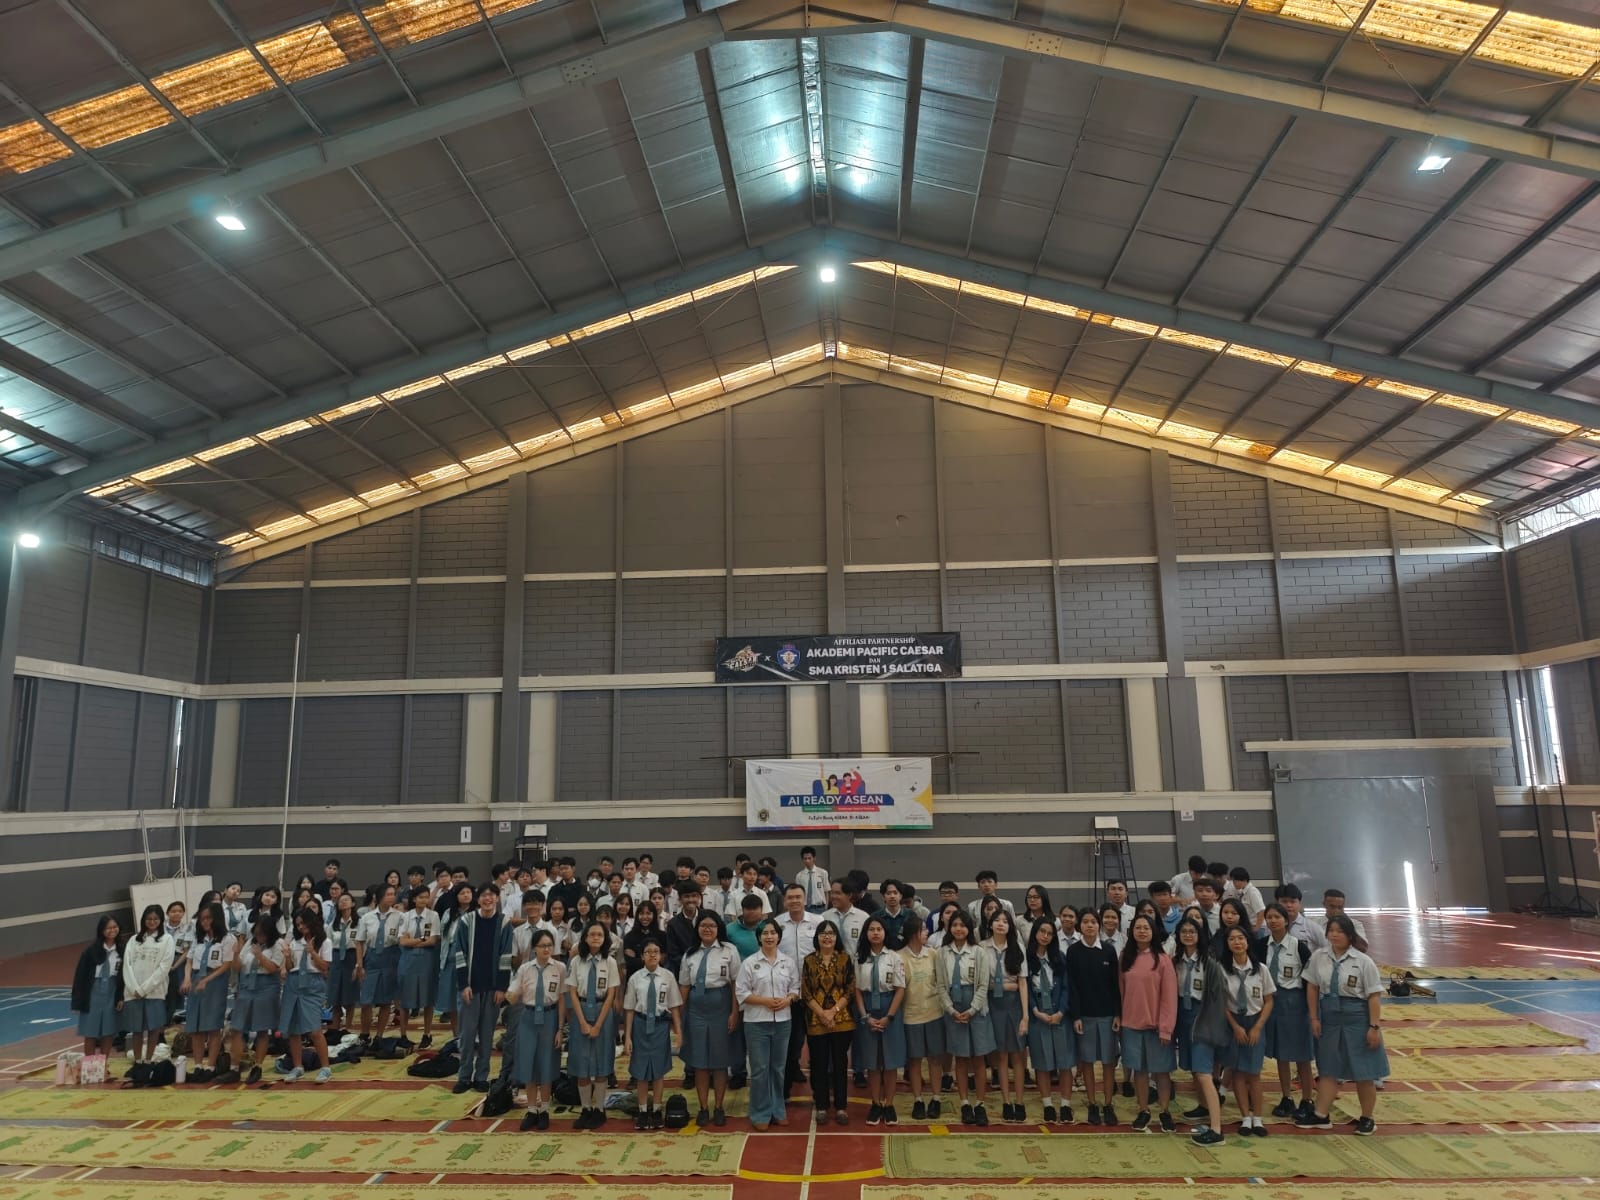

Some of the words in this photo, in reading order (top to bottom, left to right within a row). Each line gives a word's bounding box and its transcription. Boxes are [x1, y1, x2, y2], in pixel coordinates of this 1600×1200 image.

[833, 638, 866, 646] AFFILIASI
[867, 637, 916, 645] PARTNERSHIP
[806, 647, 855, 658] AKADEMI
[856, 646, 898, 657] PACIFIC
[900, 645, 944, 655] CAESAR
[808, 665, 833, 675] SMA
[834, 664, 880, 674] KRISTEN
[882, 664, 887, 673] 1
[889, 663, 942, 673] SALATIGA
[787, 796, 800, 805] AI
[803, 795, 842, 805] READY
[844, 795, 884, 804] ASEAN
